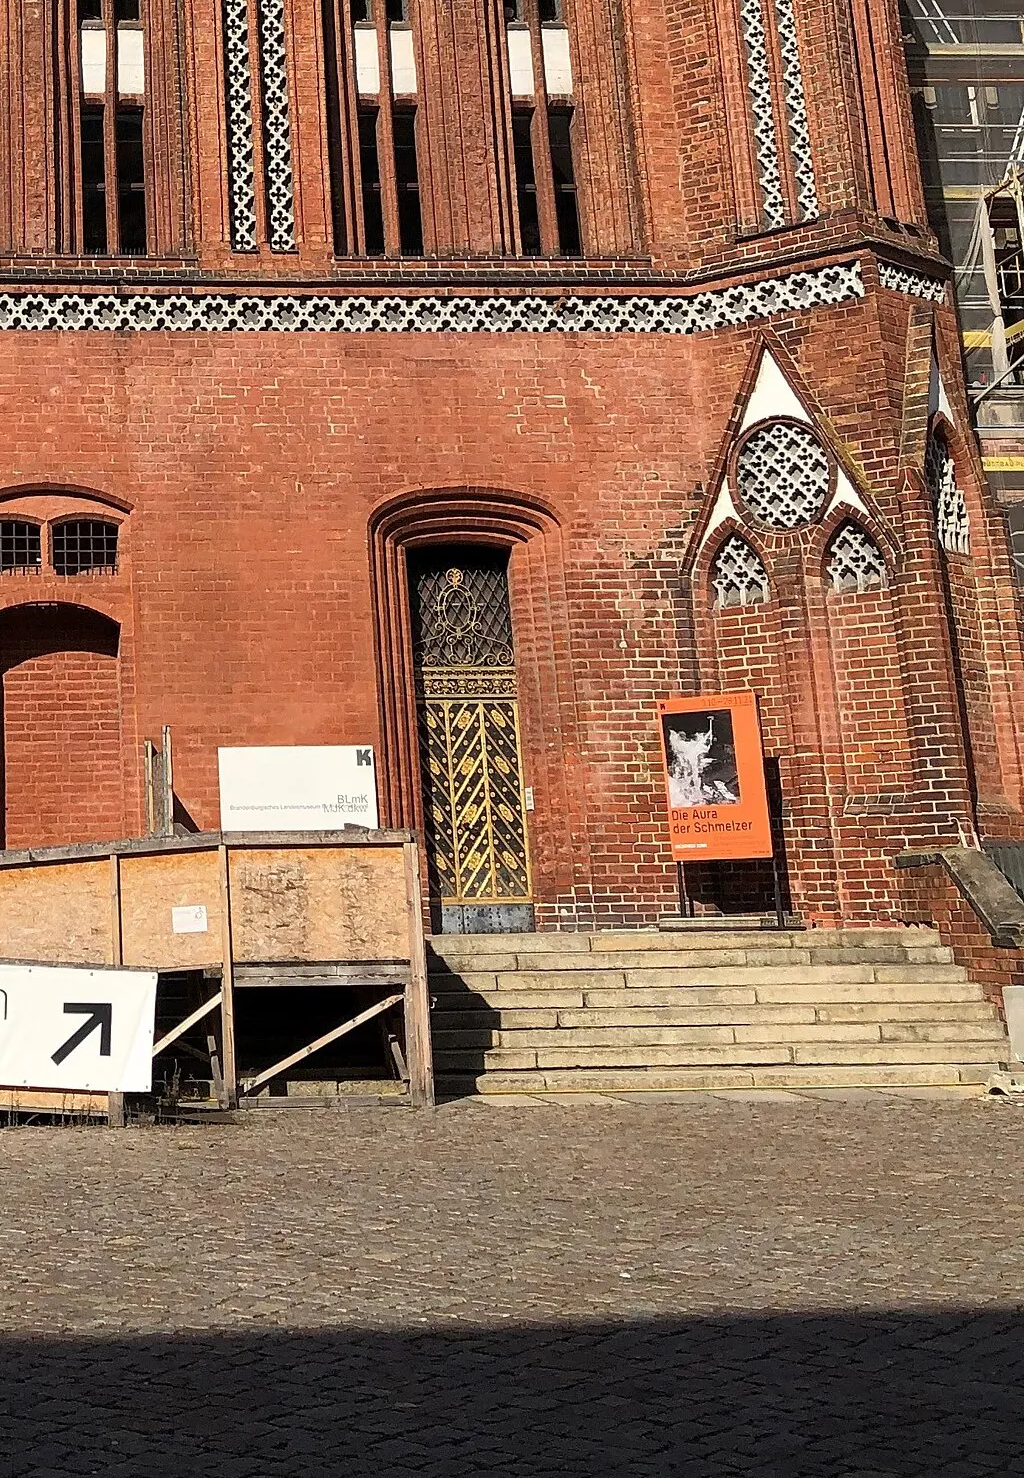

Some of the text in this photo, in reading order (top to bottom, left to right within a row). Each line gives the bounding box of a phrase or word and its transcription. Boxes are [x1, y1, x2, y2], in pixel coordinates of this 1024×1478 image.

[356, 749, 372, 766] K
[337, 794, 368, 804] BLmK
[672, 809, 717, 820] Die Aura
[673, 820, 752, 834] der Schmelzer
